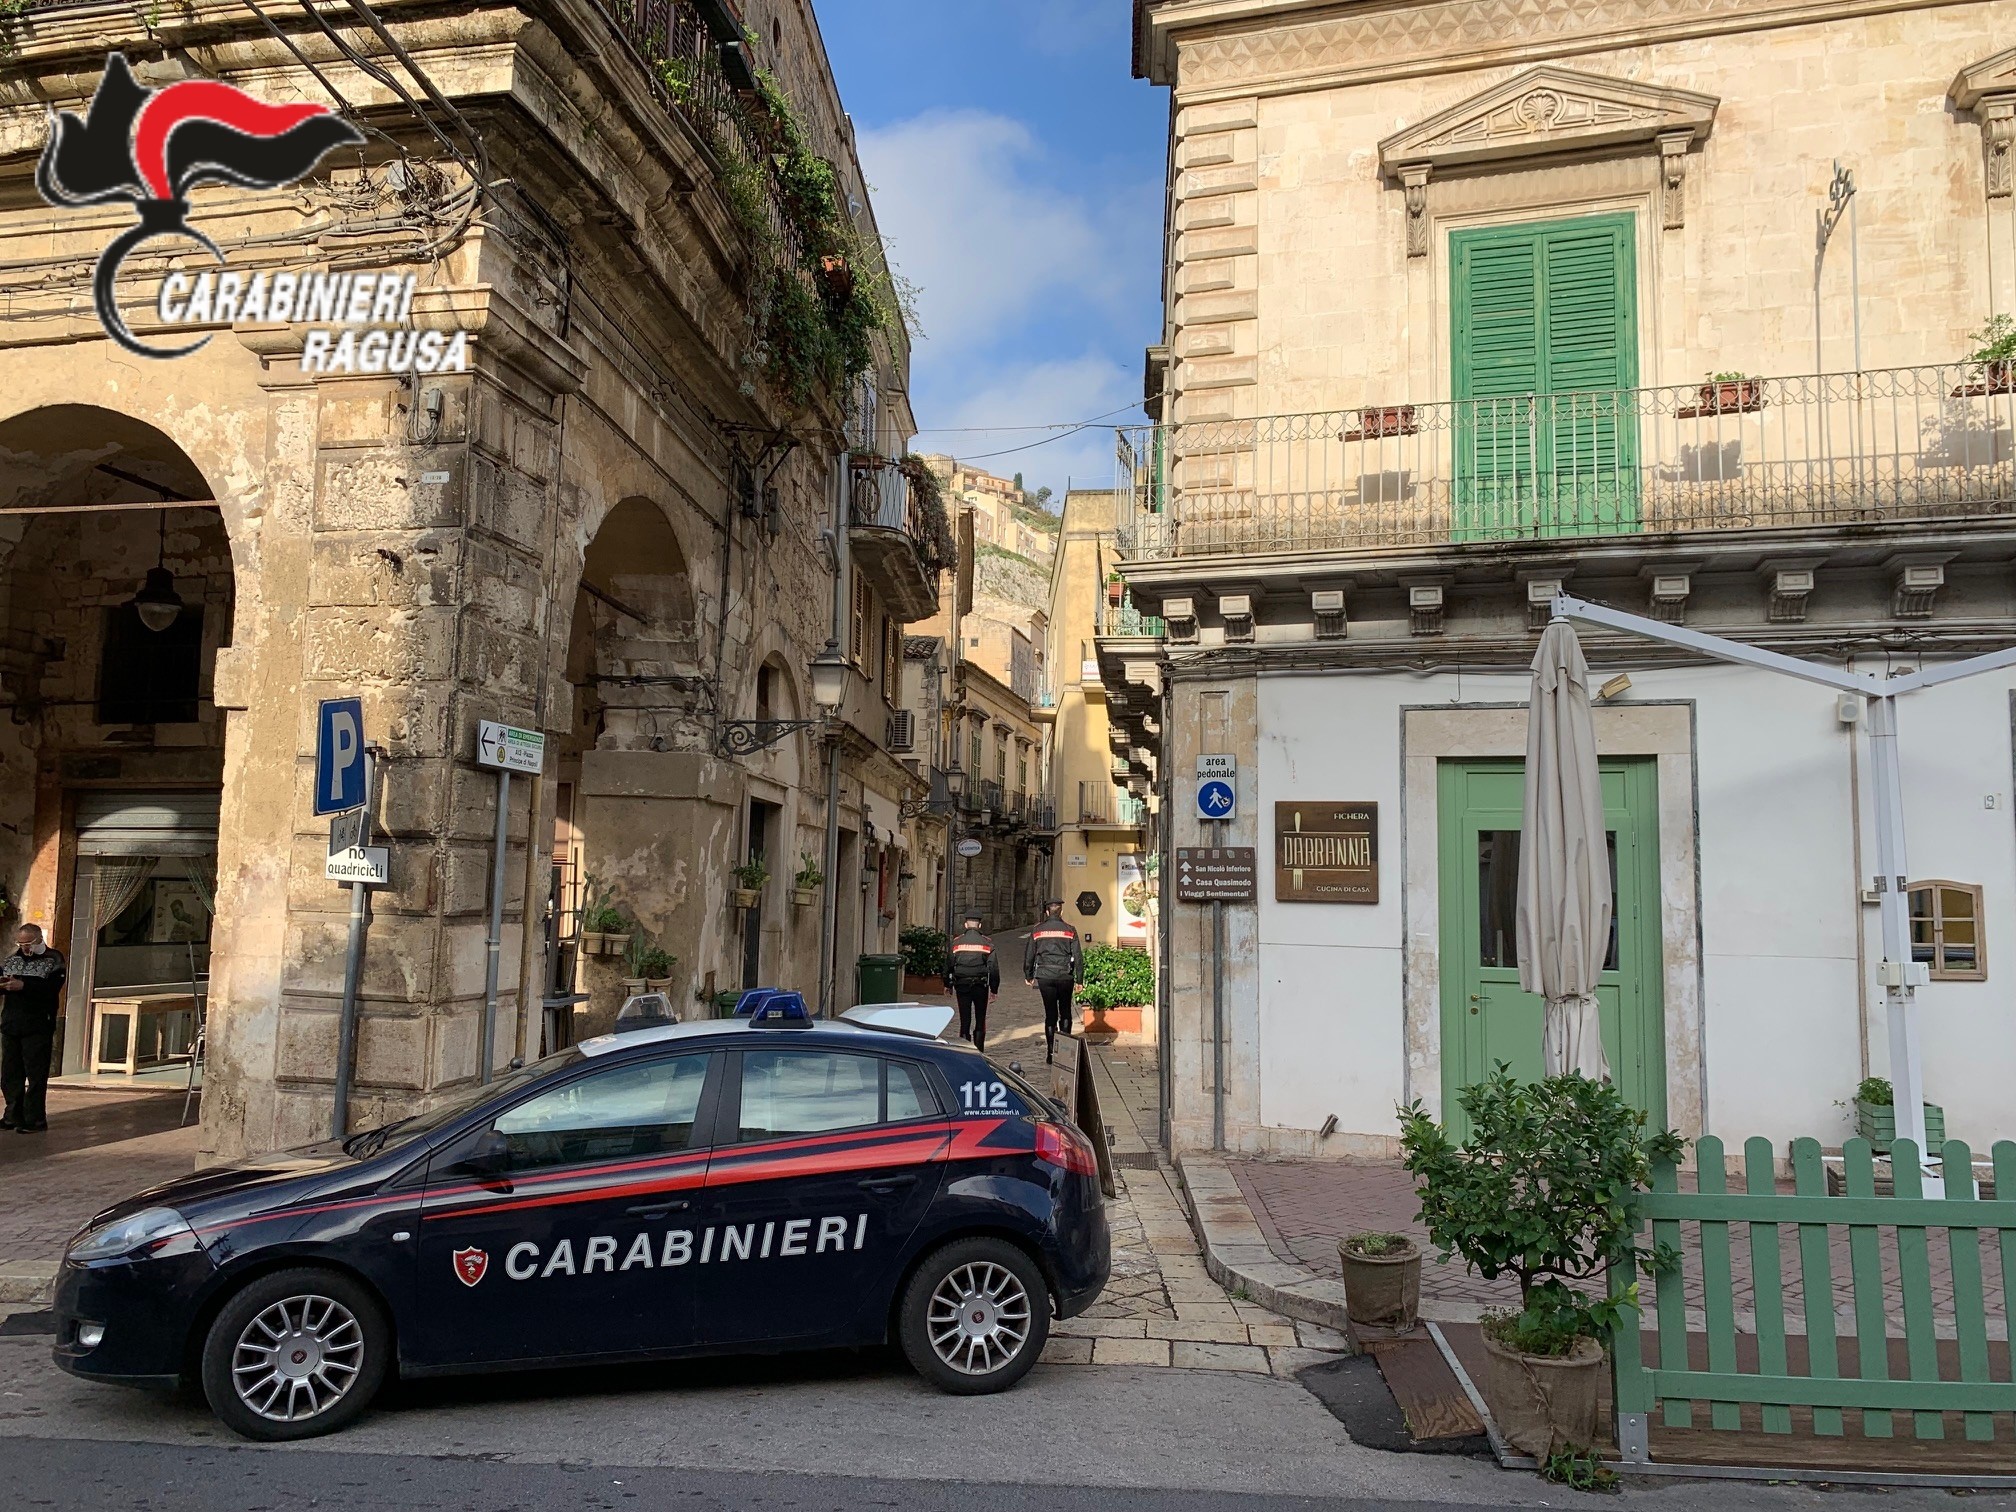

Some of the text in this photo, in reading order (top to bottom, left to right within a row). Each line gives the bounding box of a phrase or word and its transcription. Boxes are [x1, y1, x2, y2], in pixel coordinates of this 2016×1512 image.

[331, 711, 357, 800] P
[1206, 758, 1226, 766] area
[1197, 768, 1235, 780] pedonale
[349, 848, 366, 860] no
[1284, 837, 1371, 866] DABBANNA
[328, 861, 383, 878] quadricicli
[1207, 863, 1225, 872] Nicolò
[1195, 878, 1252, 887] Casa Quasimodo
[1184, 889, 1205, 898] Viaggi
[960, 1081, 1008, 1108] 112
[505, 1213, 868, 1280] CARABINIERI
